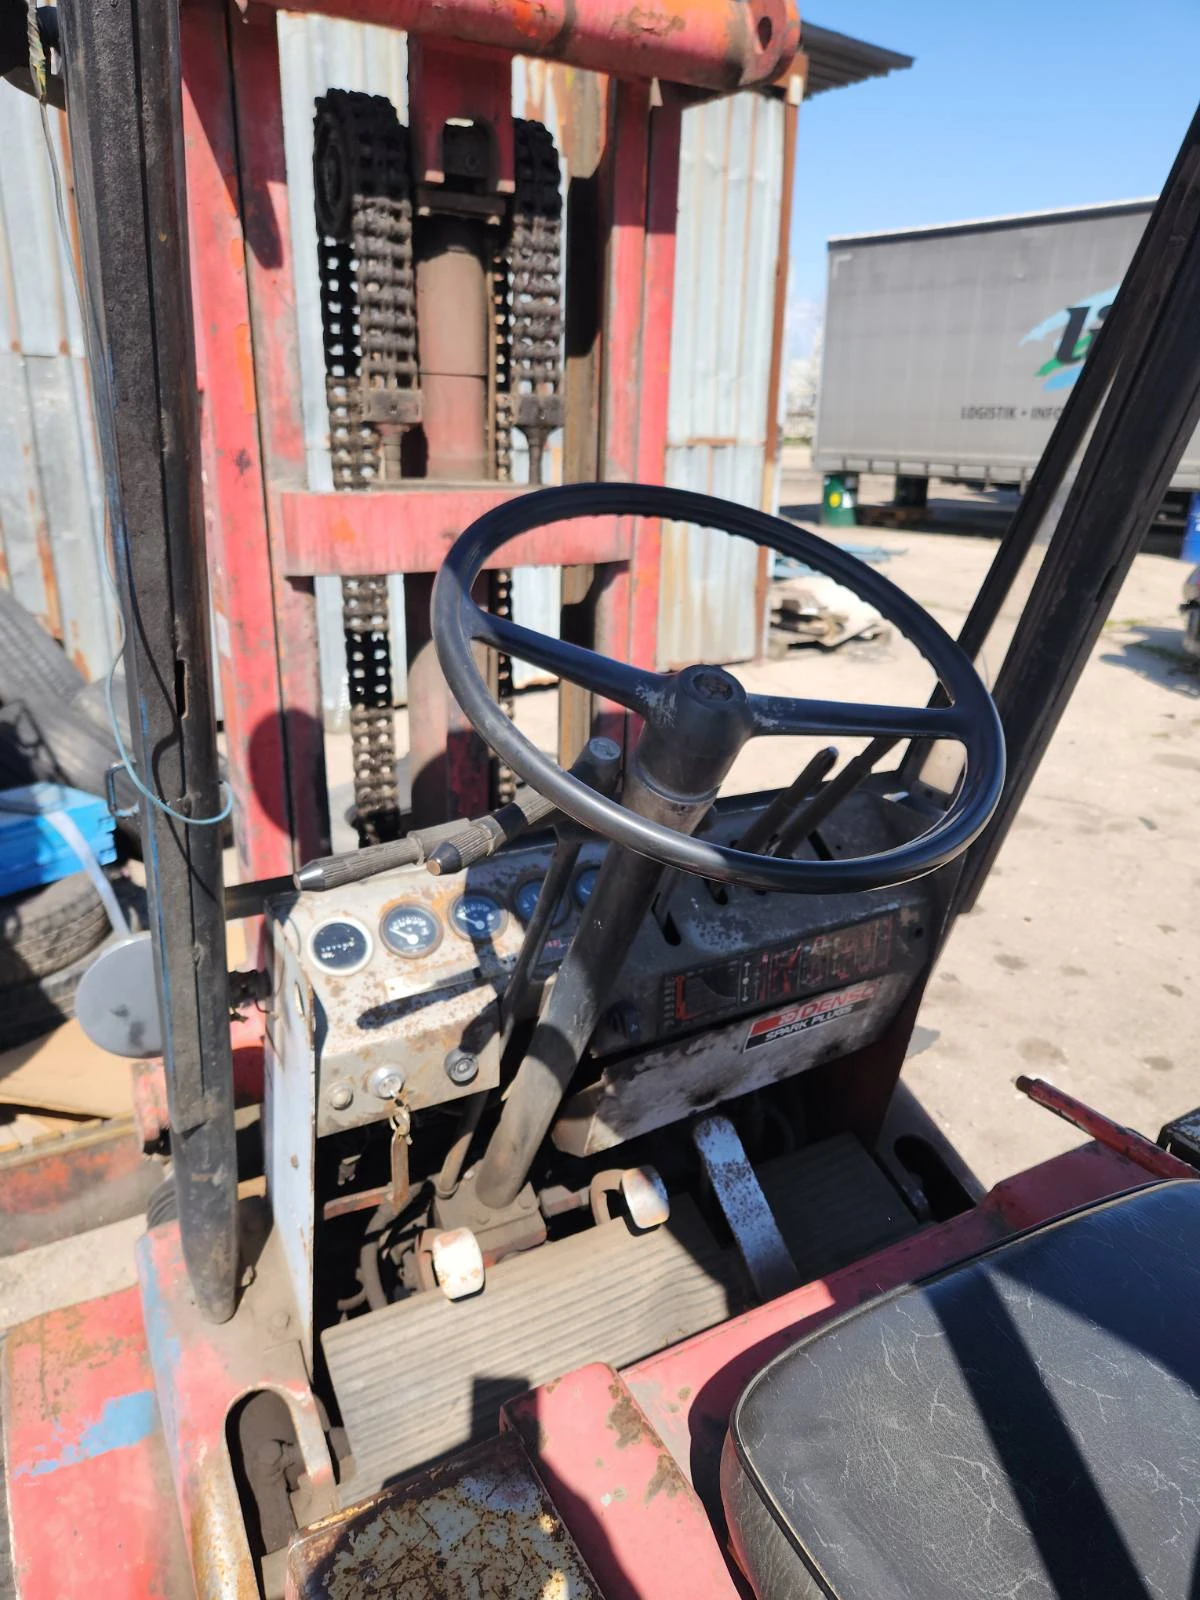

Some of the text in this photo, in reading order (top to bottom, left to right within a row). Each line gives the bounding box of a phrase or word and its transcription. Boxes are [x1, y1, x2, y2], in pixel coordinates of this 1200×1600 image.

[961, 407, 1064, 420] LOGISTIK INFO
[765, 1020, 808, 1041] SPARK
[811, 1005, 853, 1025] PLUGS
